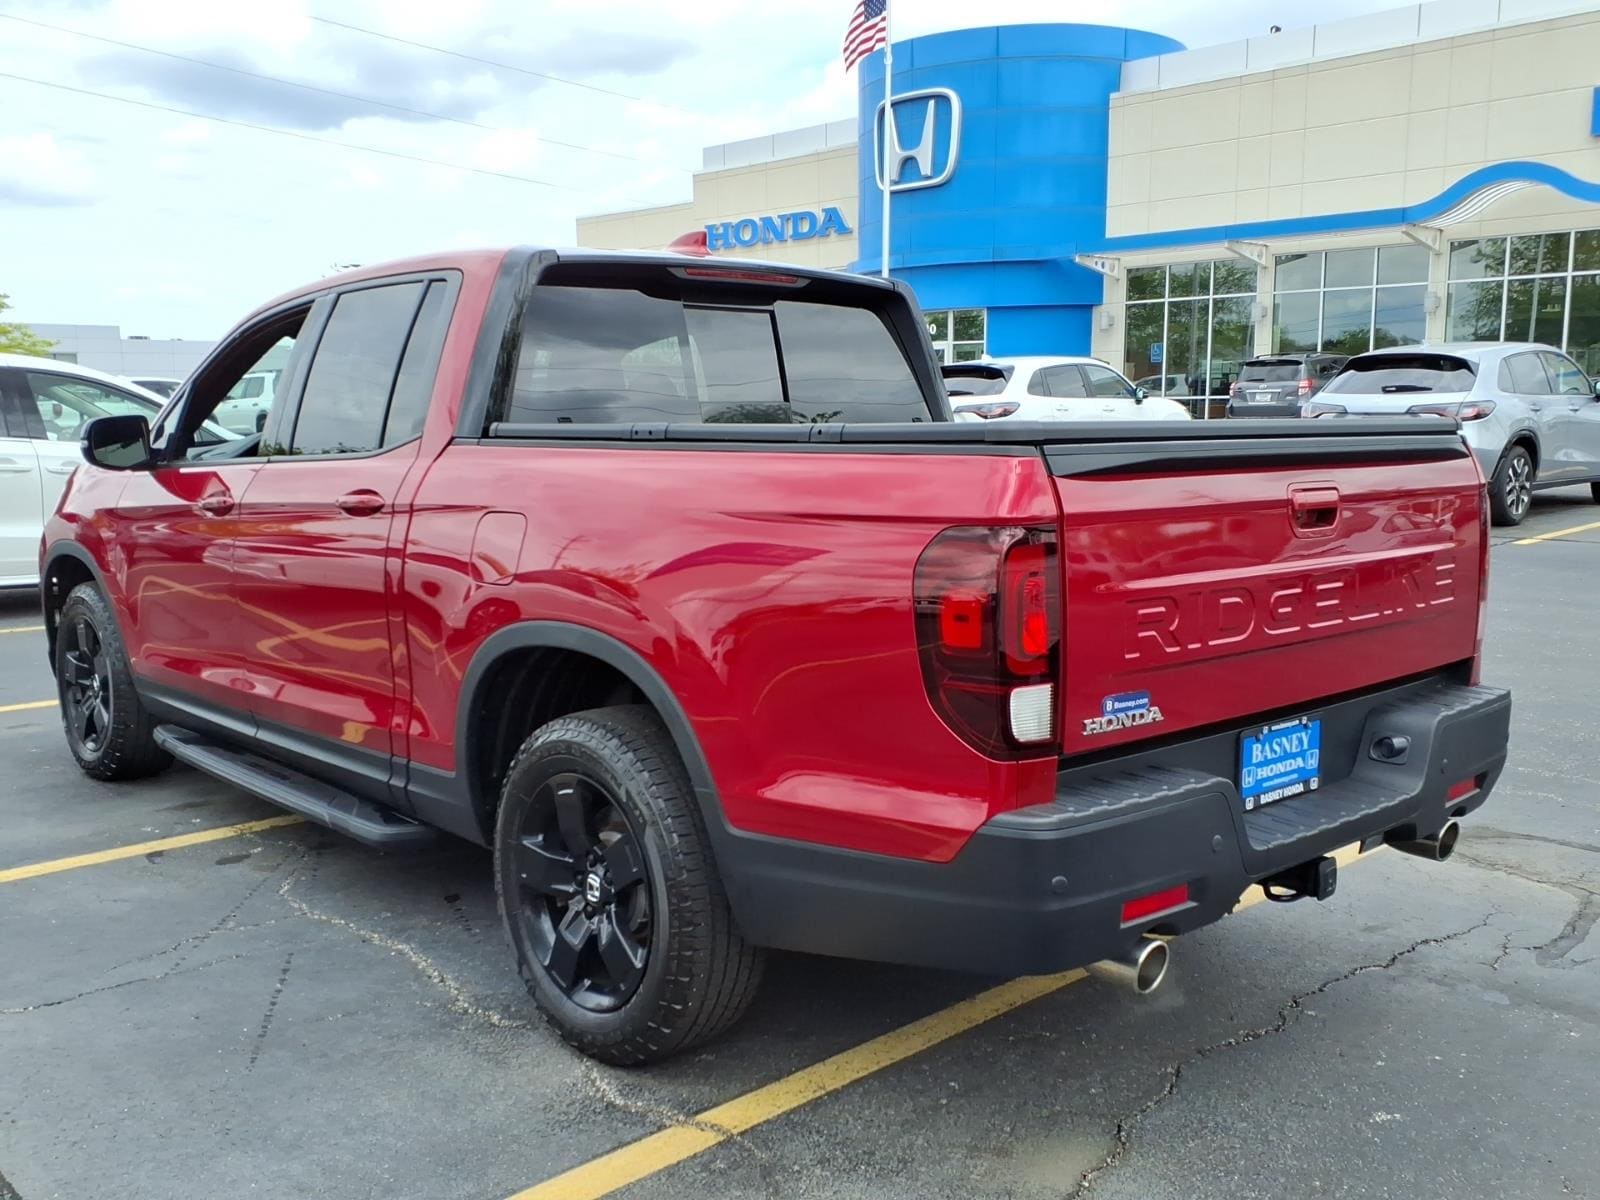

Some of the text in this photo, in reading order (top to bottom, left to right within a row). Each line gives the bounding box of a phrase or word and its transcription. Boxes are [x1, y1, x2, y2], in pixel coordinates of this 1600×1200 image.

[705, 206, 852, 251] HONDA
[1124, 555, 1456, 660] RIDGELINE
[1081, 706, 1164, 735] HONDA
[1252, 730, 1312, 764] BASNEY
[1256, 757, 1305, 780] HONDA
[1260, 782, 1304, 804] BASNEY HONDA
